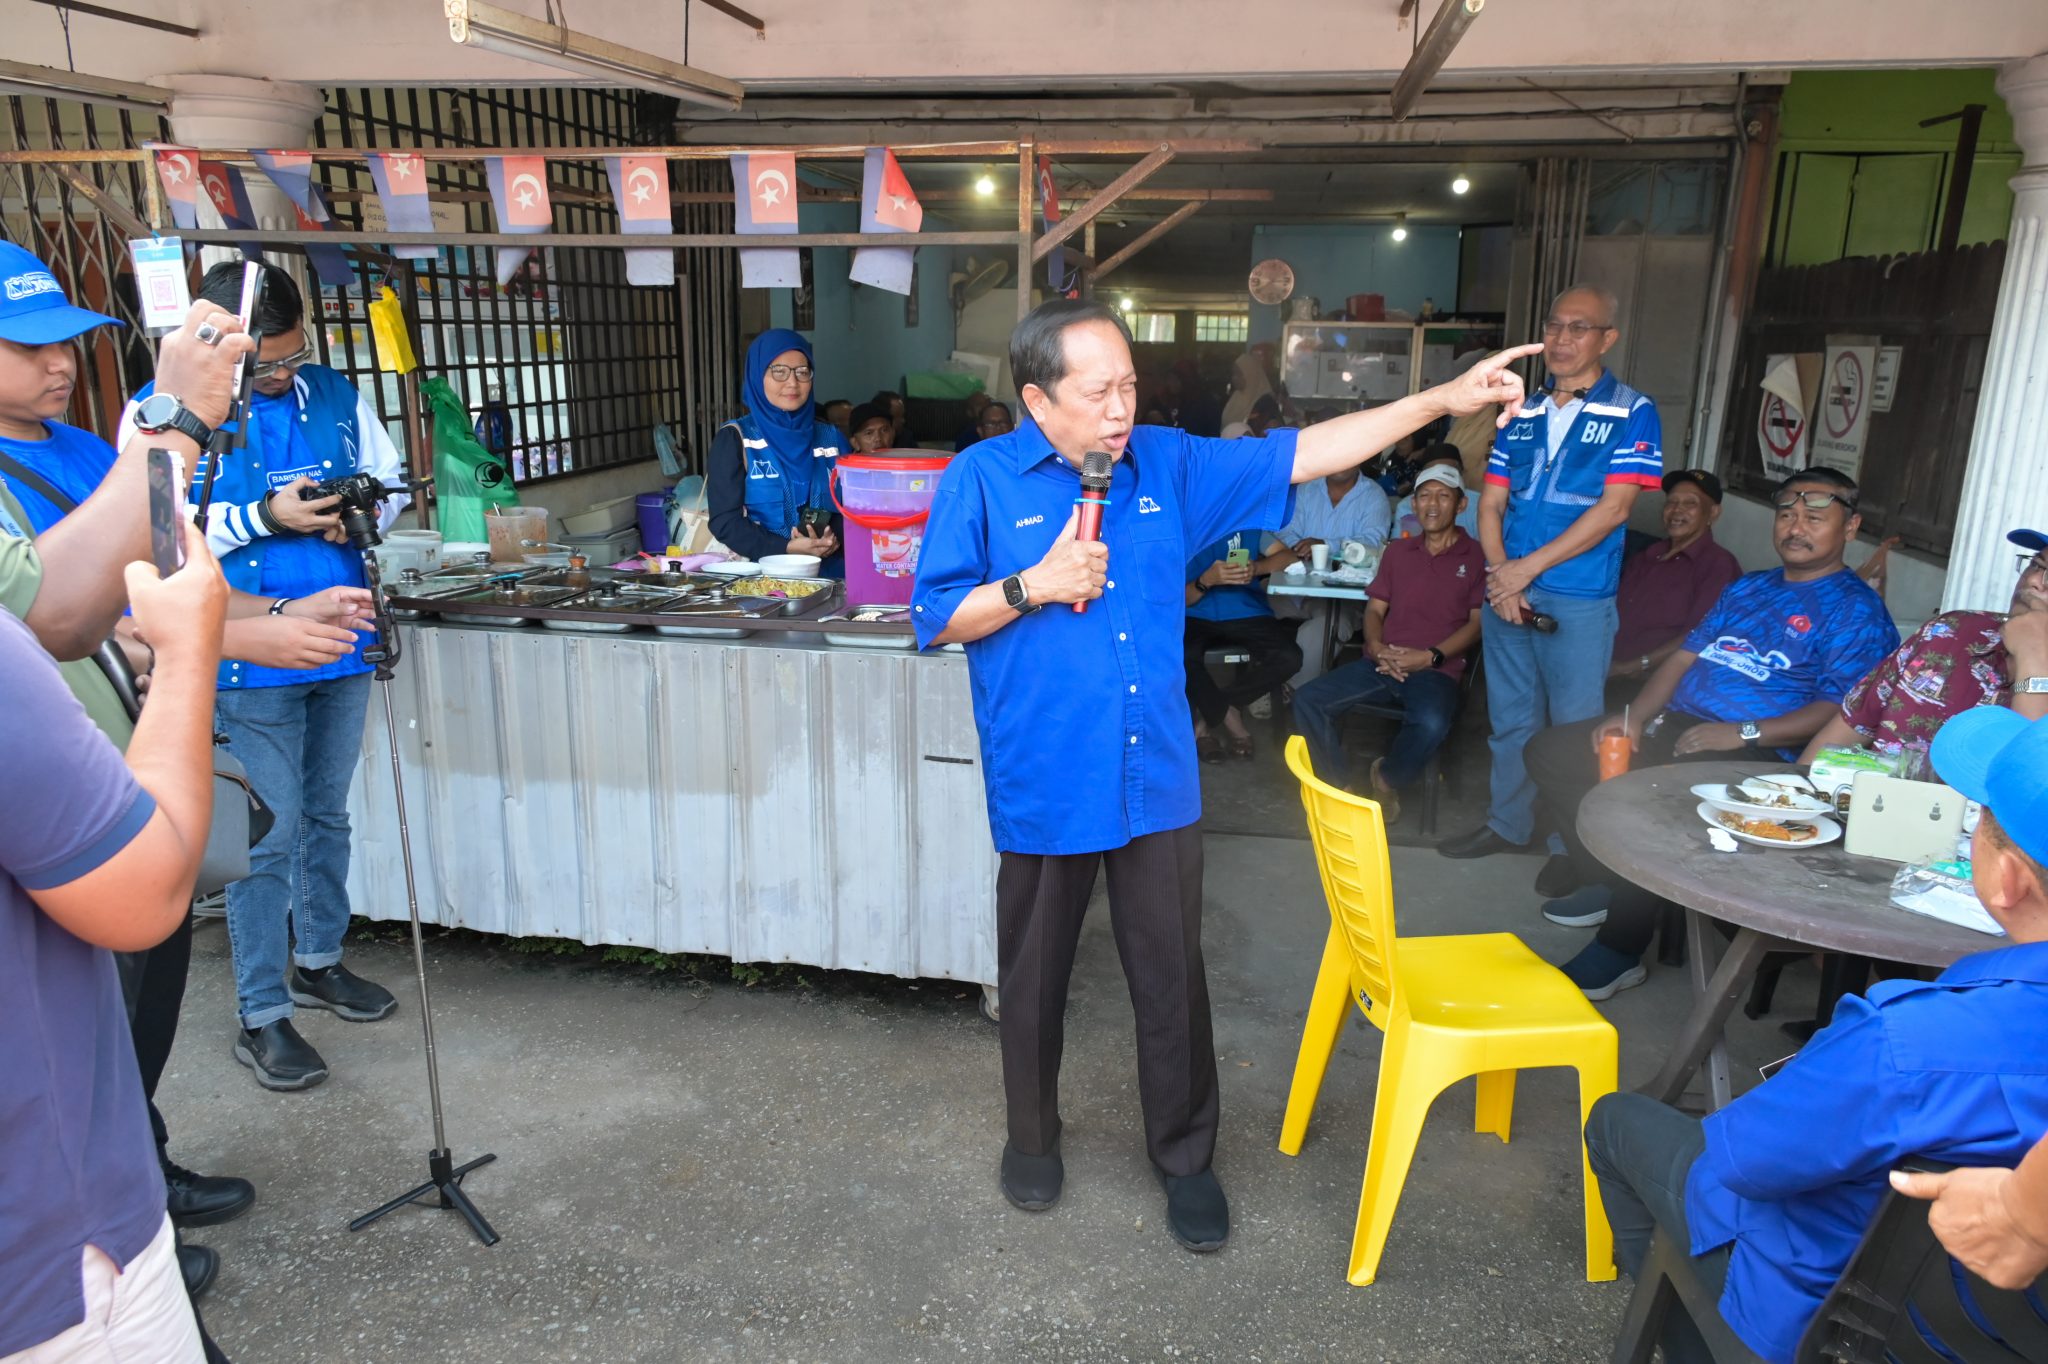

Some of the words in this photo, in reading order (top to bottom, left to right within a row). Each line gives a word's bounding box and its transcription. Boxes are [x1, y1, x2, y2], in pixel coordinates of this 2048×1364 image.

[1580, 420, 1614, 444] BN
[271, 471, 307, 483] BARISAN
[1015, 514, 1044, 529] AHMAD
